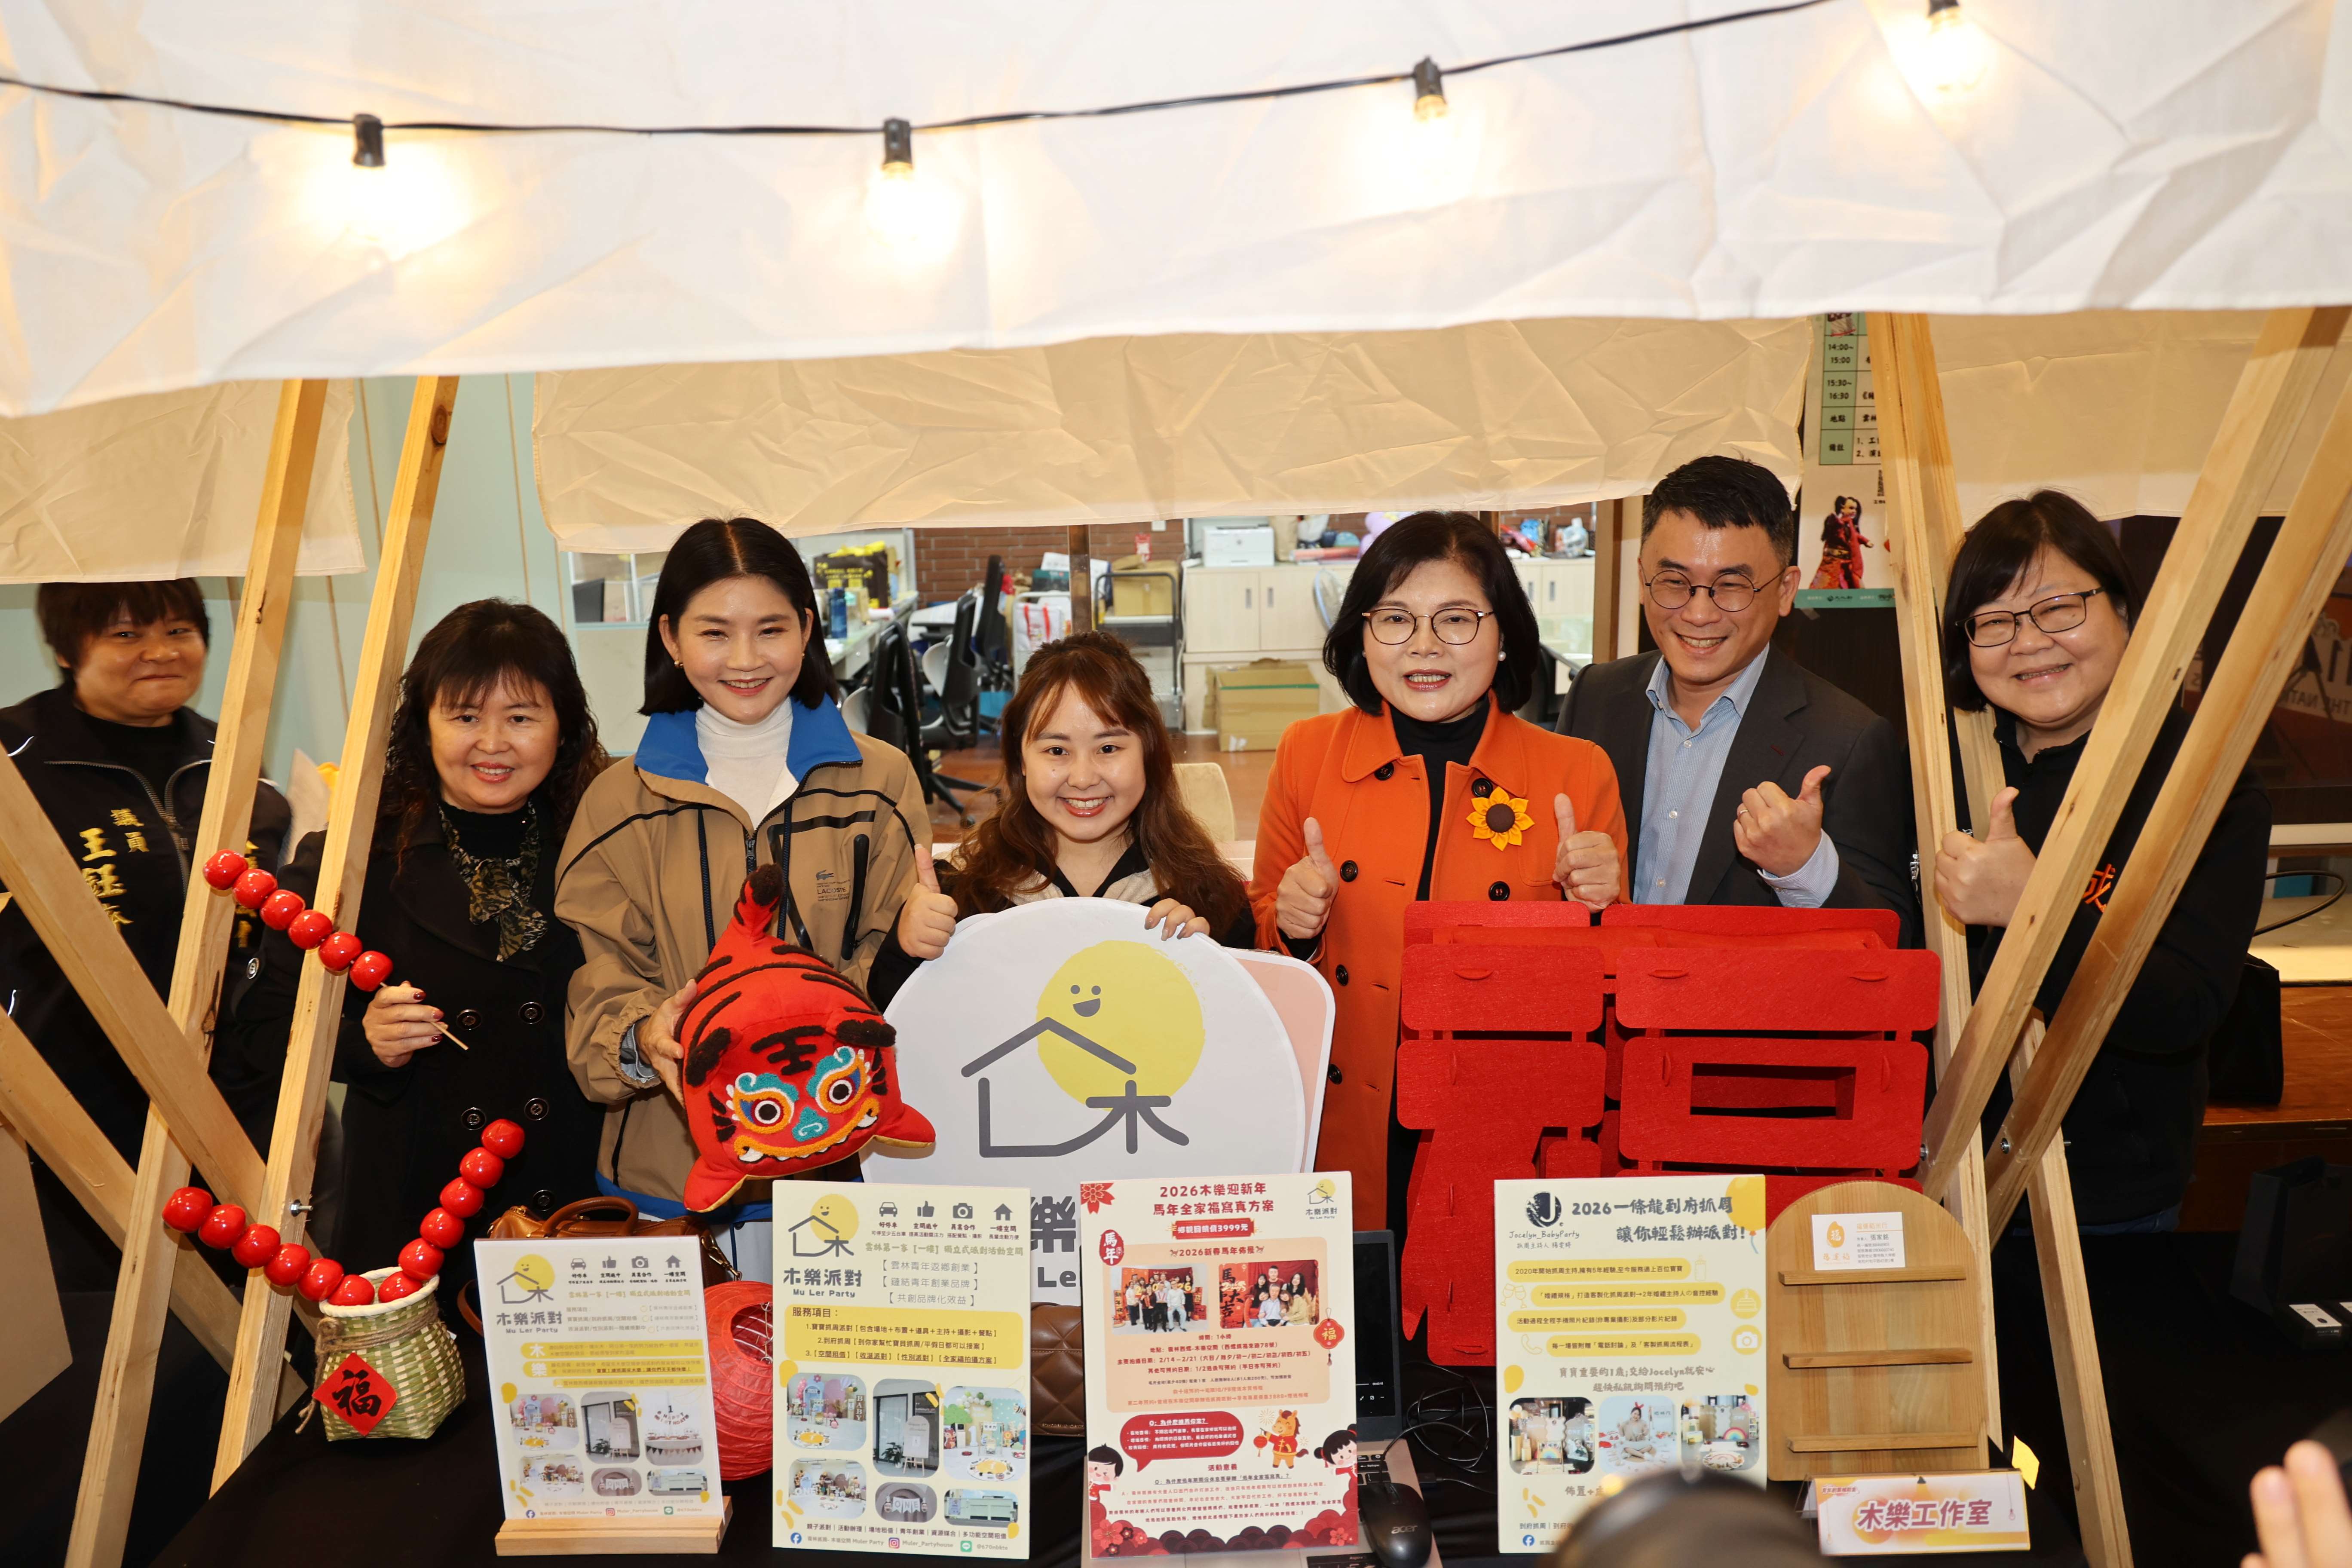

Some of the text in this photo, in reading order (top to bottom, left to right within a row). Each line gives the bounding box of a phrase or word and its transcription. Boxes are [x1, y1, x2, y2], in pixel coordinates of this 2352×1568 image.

[110, 808, 150, 853] 議員
[1160, 1182, 1267, 1198] 2026木樂迎新年
[1153, 1200, 1274, 1216] 馬年全家福寫真方案
[1305, 1207, 1337, 1216] 木樂派對
[1572, 1196, 1733, 1216] 2026一條龍到府抓周
[1031, 1196, 1076, 1253] 樂
[1509, 1229, 1580, 1240] Jocelyn_BabyParty
[865, 1242, 908, 1253] 雲林第一家
[944, 1245, 1024, 1256] 獨立式派對活動空間
[1103, 1232, 1120, 1265] 馬年
[1179, 1246, 1255, 1256] 2026新春馬年佈景
[1516, 1241, 1549, 1250] 抓周主持人
[783, 1268, 862, 1287] 木樂派對
[1038, 1267, 1076, 1288] Le
[829, 1289, 855, 1298] Party
[496, 1311, 562, 1326] 木樂派對
[1322, 1327, 1336, 1340] 福
[529, 1344, 545, 1358] 木
[531, 1362, 547, 1376] 樂
[331, 1369, 382, 1417] 福
[1207, 1463, 1237, 1472] 活動意義
[1857, 1499, 1993, 1530] 木樂工作室
[1391, 1525, 1418, 1534] acer
